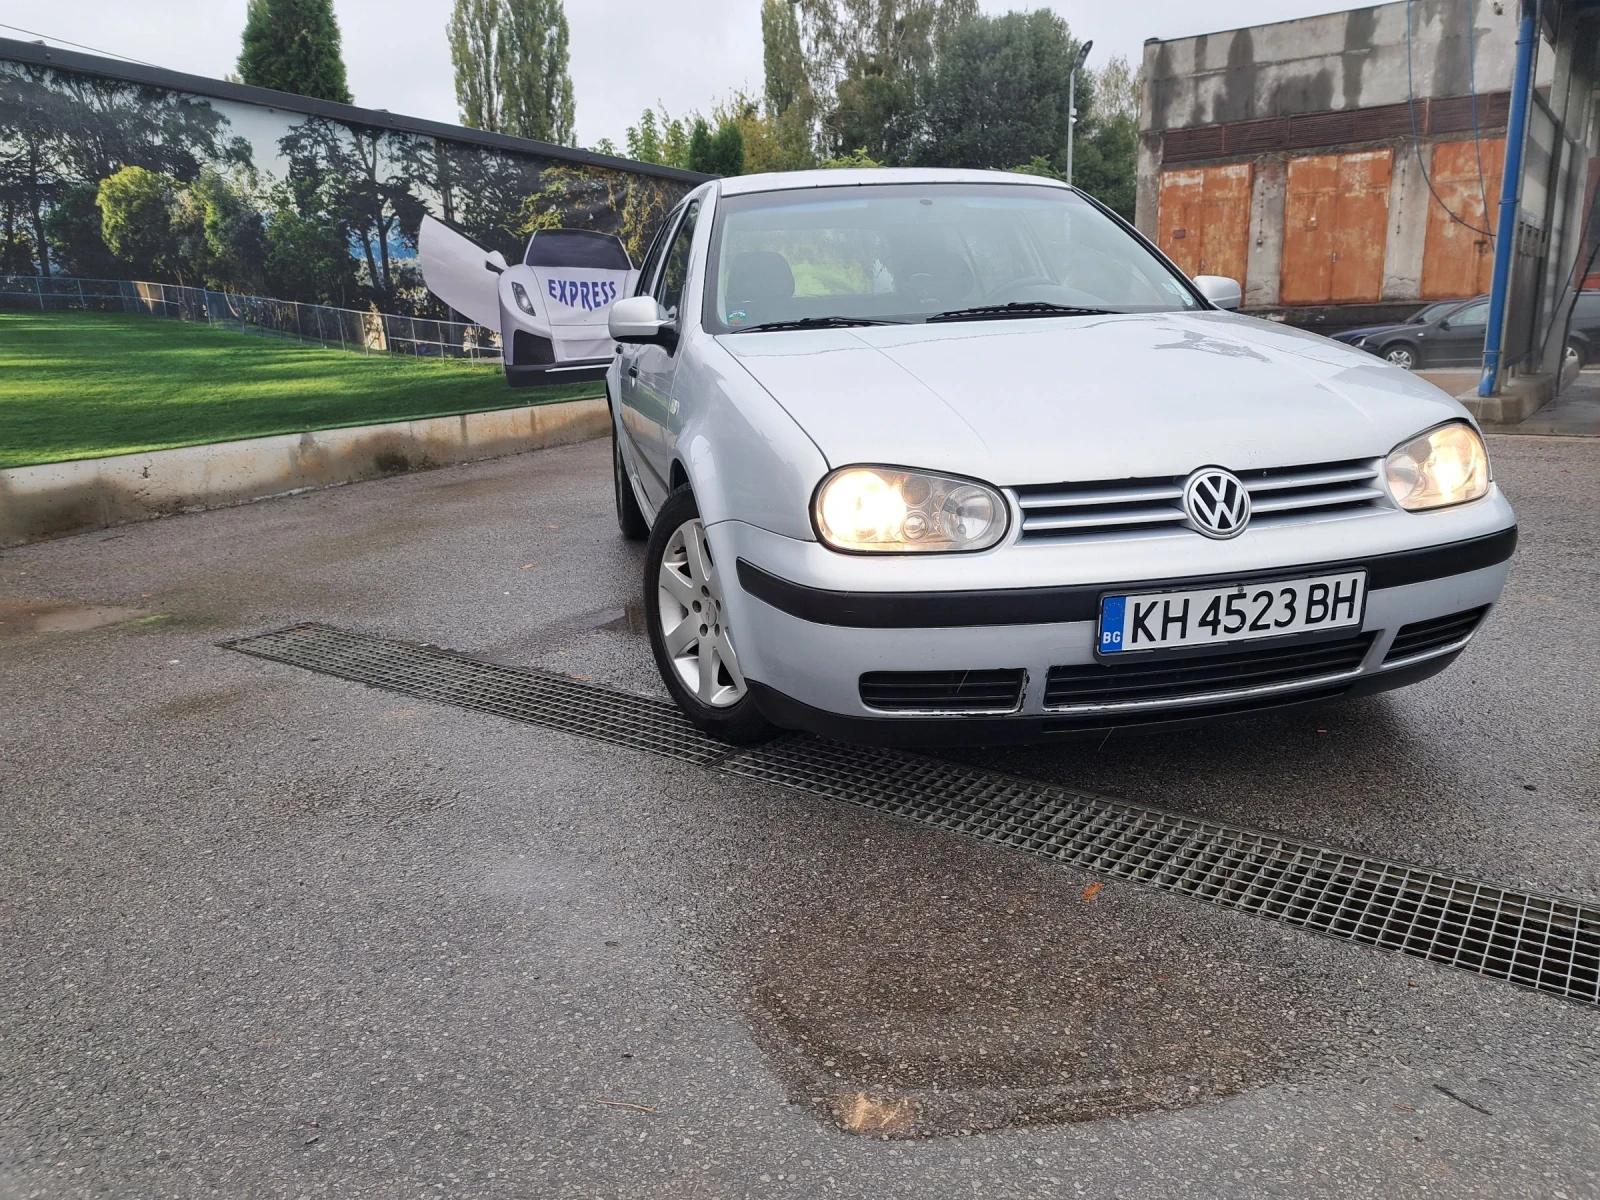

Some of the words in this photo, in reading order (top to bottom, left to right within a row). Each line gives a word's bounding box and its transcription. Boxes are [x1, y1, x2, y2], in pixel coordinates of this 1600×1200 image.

[548, 279, 616, 312] EXPRESS
[1190, 472, 1245, 531] VW
[1131, 599, 1190, 643] KH
[1198, 587, 1297, 636] 4523
[1304, 578, 1358, 625] BH
[1102, 631, 1121, 644] BG
